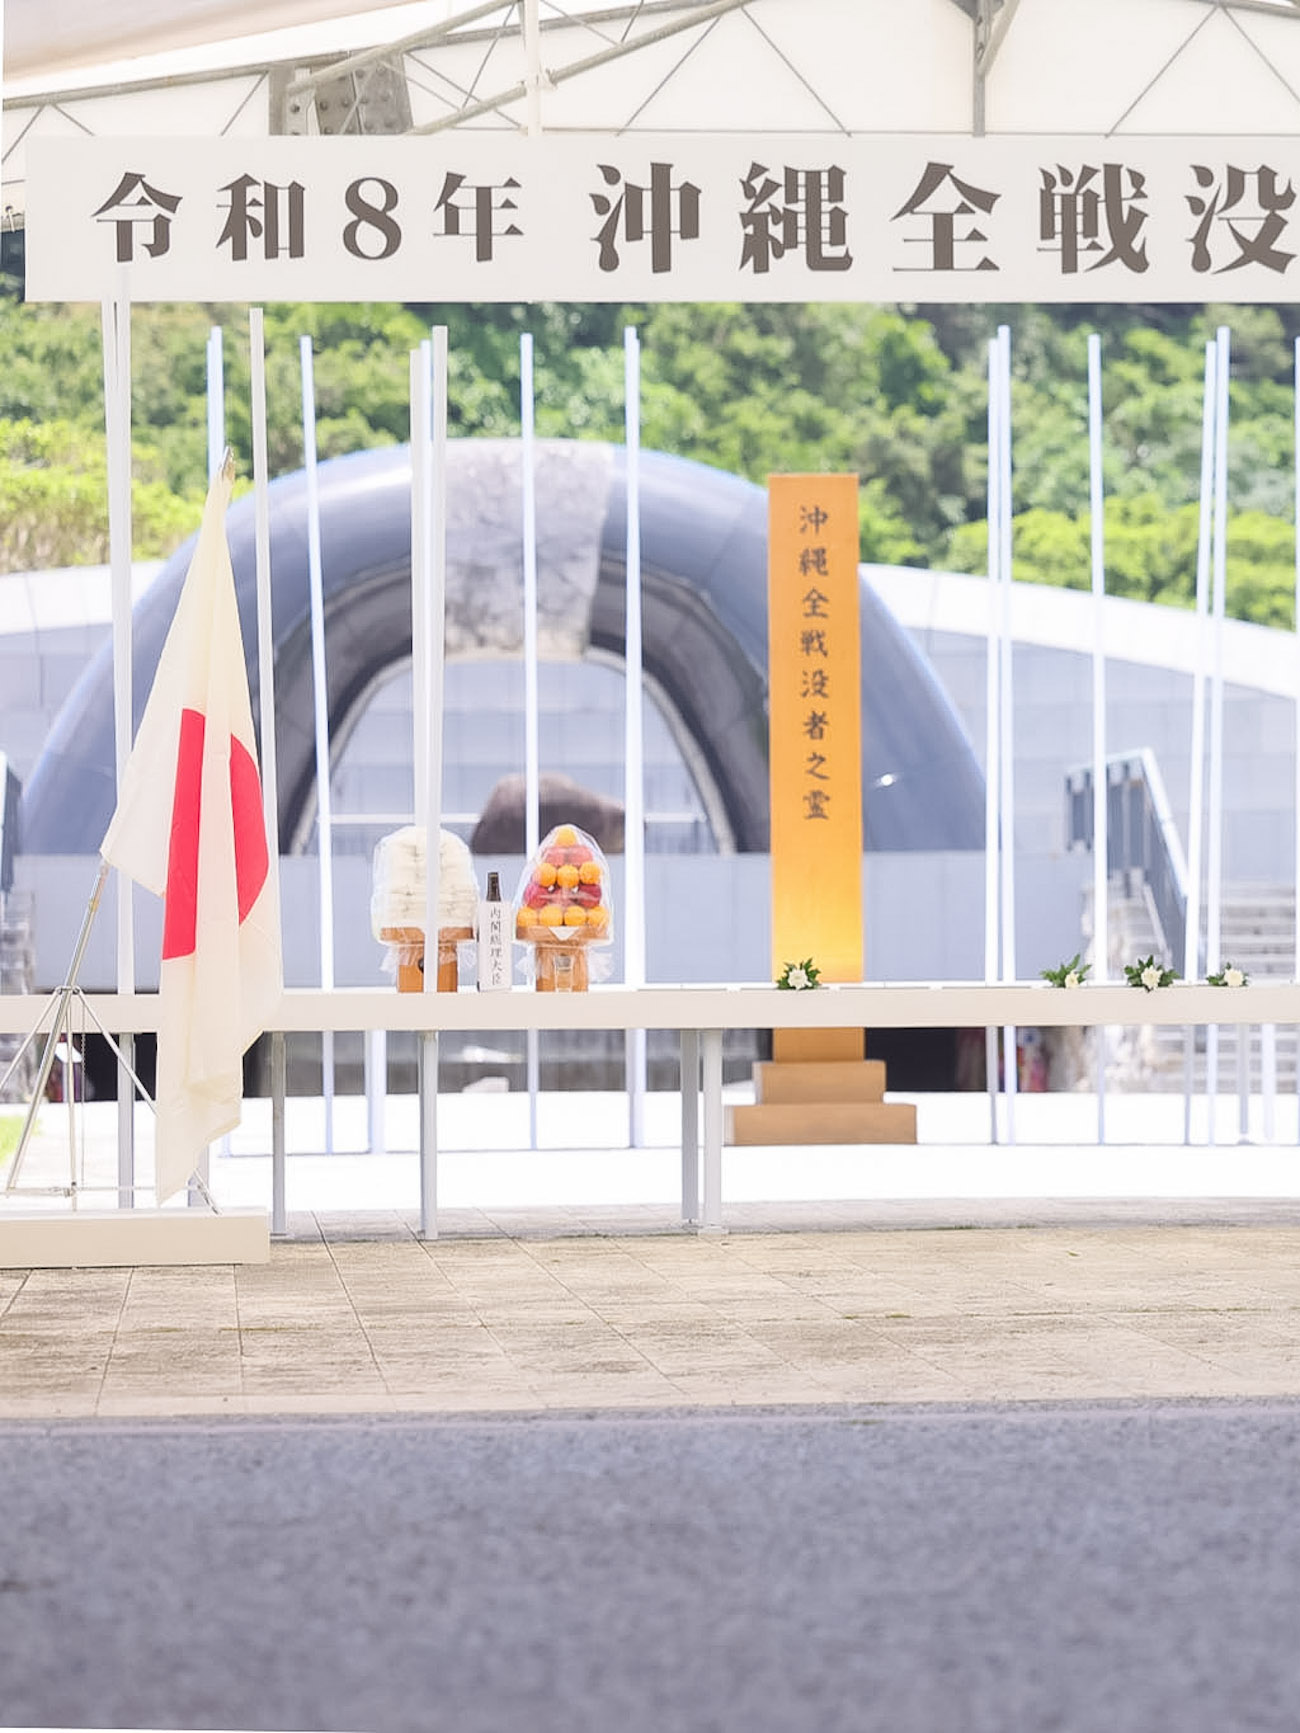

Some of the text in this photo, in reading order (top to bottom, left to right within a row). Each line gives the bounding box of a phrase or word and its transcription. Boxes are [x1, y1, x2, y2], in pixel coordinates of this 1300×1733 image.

[91, 171, 524, 264] 令和8年
[799, 505, 831, 820] 沖縄全戦没者之霊
